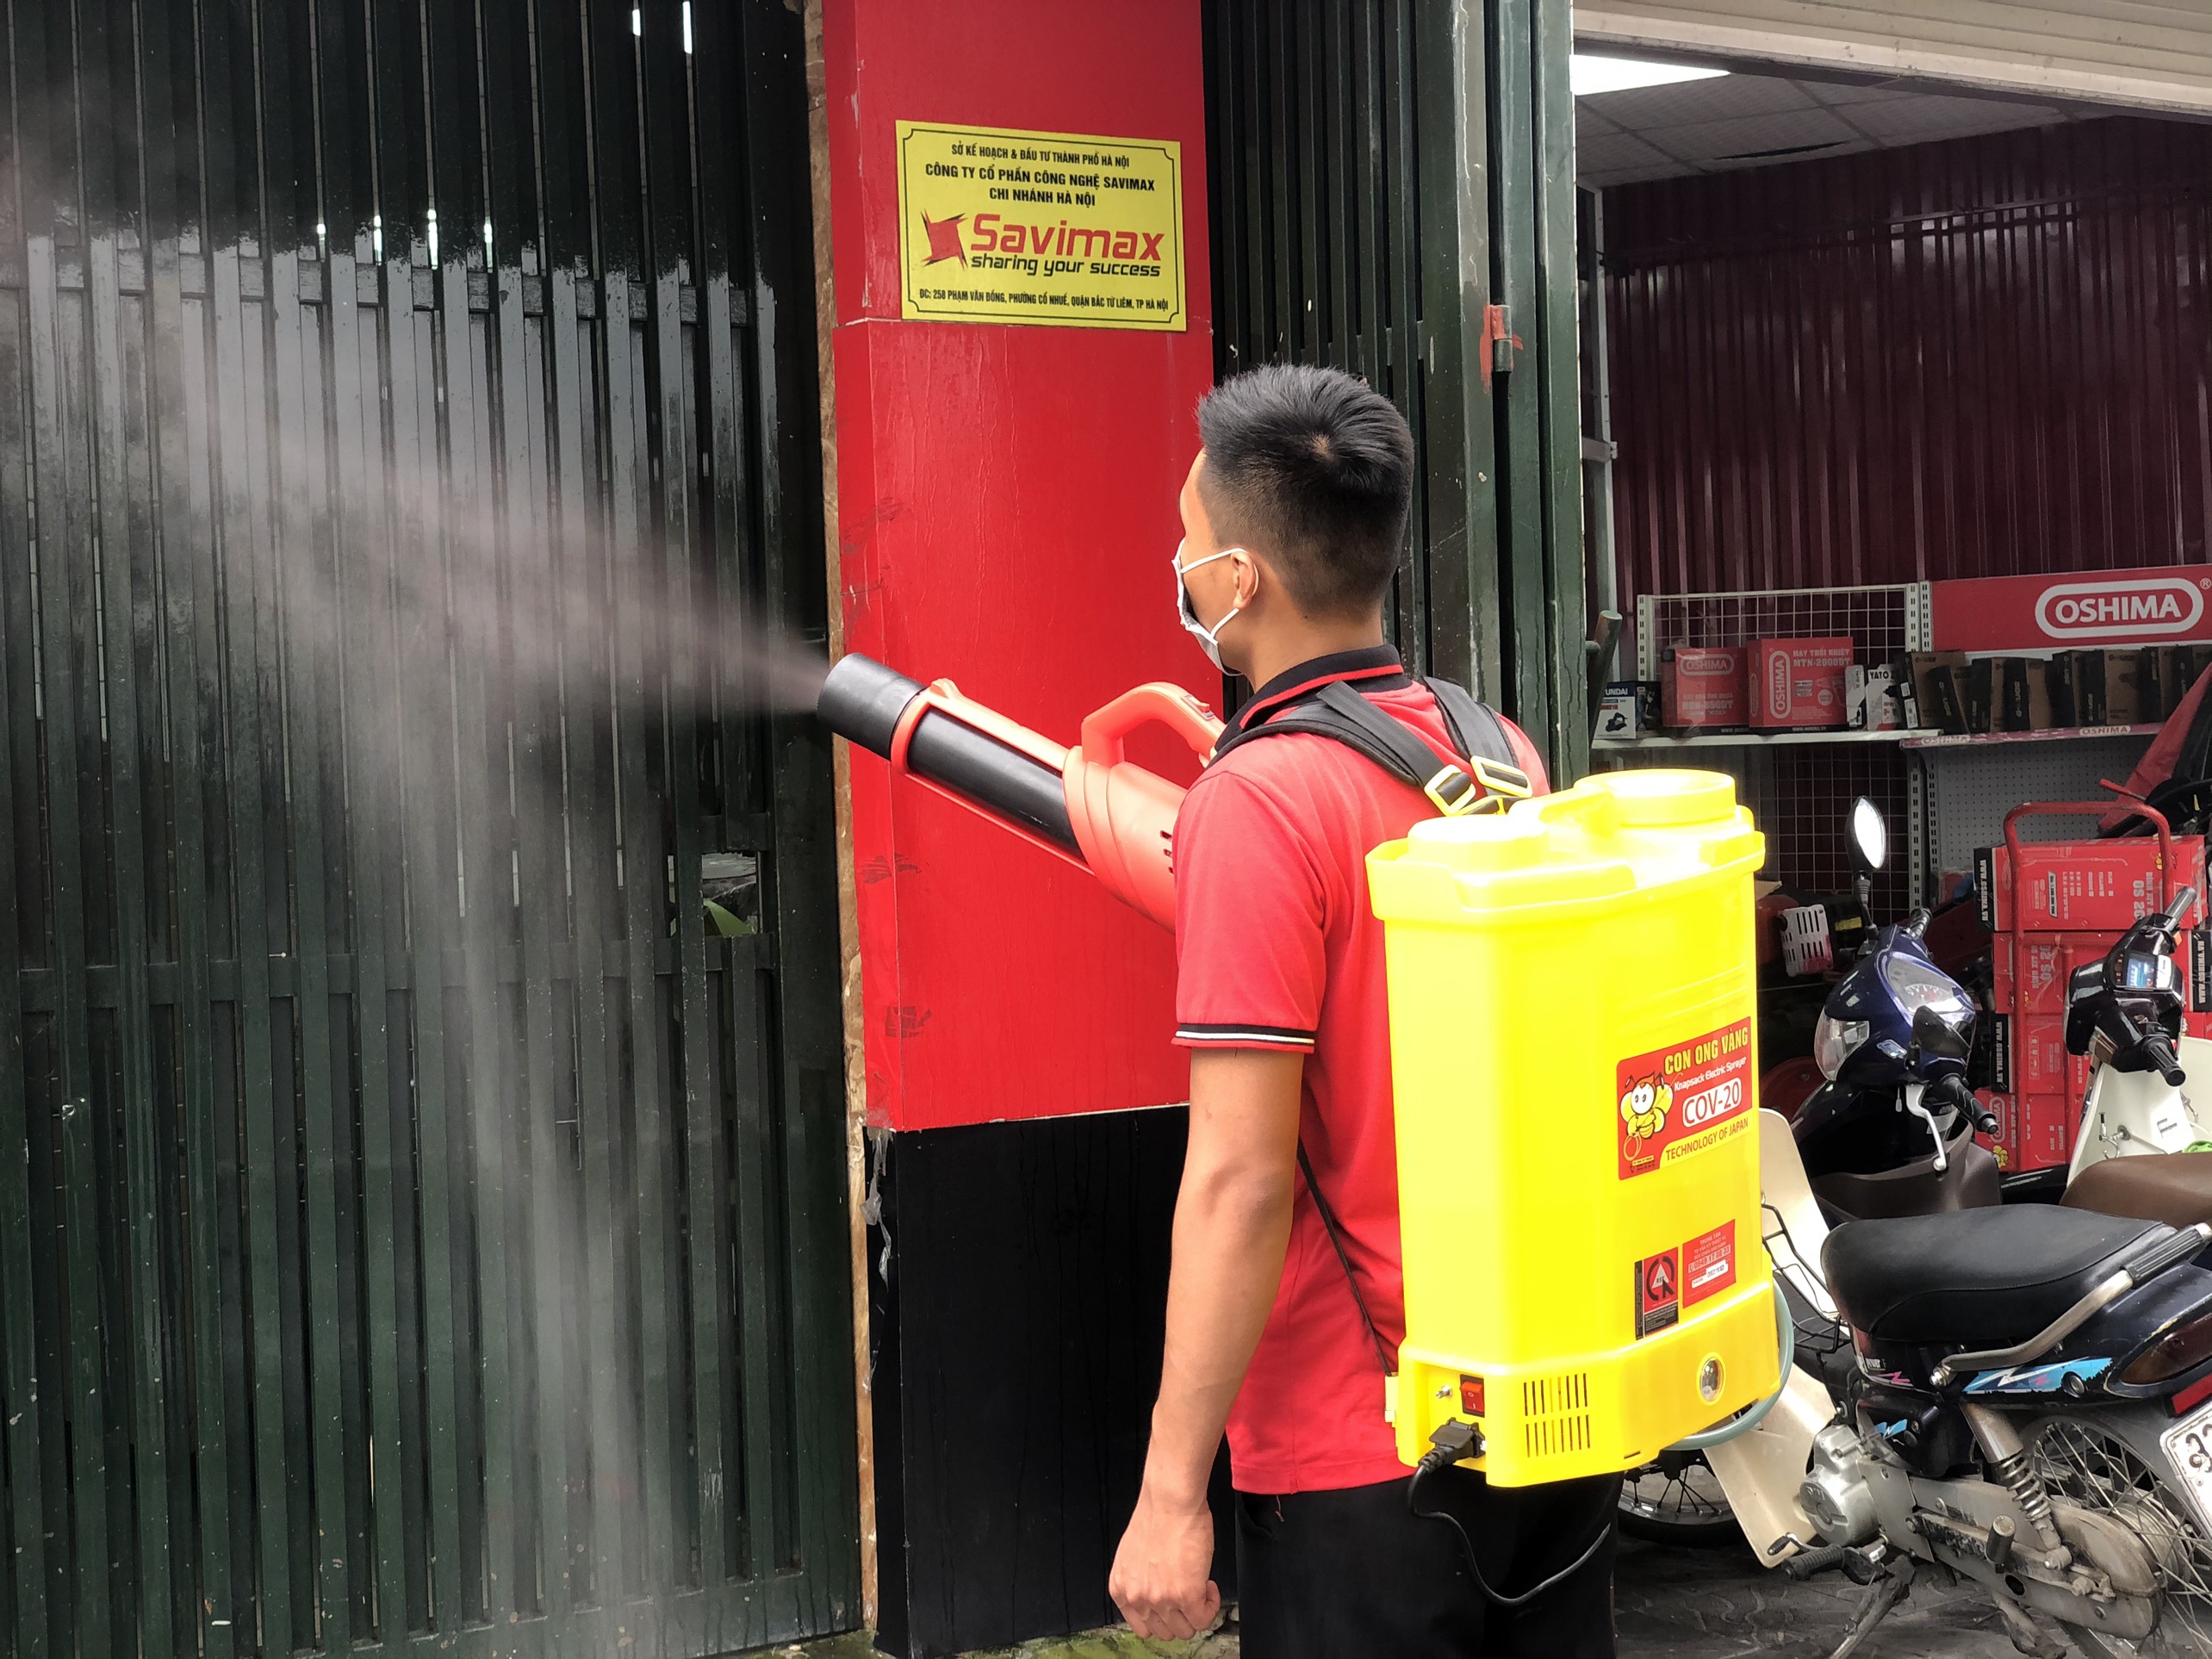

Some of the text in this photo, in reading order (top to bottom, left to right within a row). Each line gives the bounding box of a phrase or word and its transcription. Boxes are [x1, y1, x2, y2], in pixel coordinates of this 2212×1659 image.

[952, 140, 963, 155] SỞ
[966, 142, 978, 156] KẾ
[979, 146, 1008, 160] HOẠCH
[1011, 149, 1017, 159] &
[1052, 151, 1080, 164] THÀNH
[1102, 154, 1113, 166] HÀ
[1115, 155, 1129, 170] NỘI
[926, 161, 958, 177] CÔNG
[961, 166, 975, 178] TY
[1034, 170, 1066, 185] CÔNG
[1070, 173, 1100, 190] NGHỆ
[1103, 177, 1155, 191] SAVIMAX
[990, 188, 1096, 208] CHI NHÁNH HÀ NỘI
[970, 213, 1165, 261] Savimax
[971, 253, 1161, 276] sharing your success
[933, 289, 946, 300] 258
[948, 289, 968, 302] PHẠM
[1136, 299, 1144, 308] TP
[1146, 298, 1154, 309] HÀ
[1157, 298, 1168, 312] NỘI
[2055, 594, 2182, 624] OSHIMA
[1687, 660, 1728, 670] OSHIMA
[1869, 671, 1889, 680] YATO
[1774, 659, 1786, 711] OSHIMA
[2082, 726, 2128, 735] OSHIMA
[1664, 1027, 1748, 1075] CON ONG VÀNG
[1675, 1056, 1747, 1091] Knapsack Electric Sprayer
[1684, 1081, 1740, 1124] COV-20
[1666, 1117, 1749, 1161] TECHNOLOGY OF JAPAN
